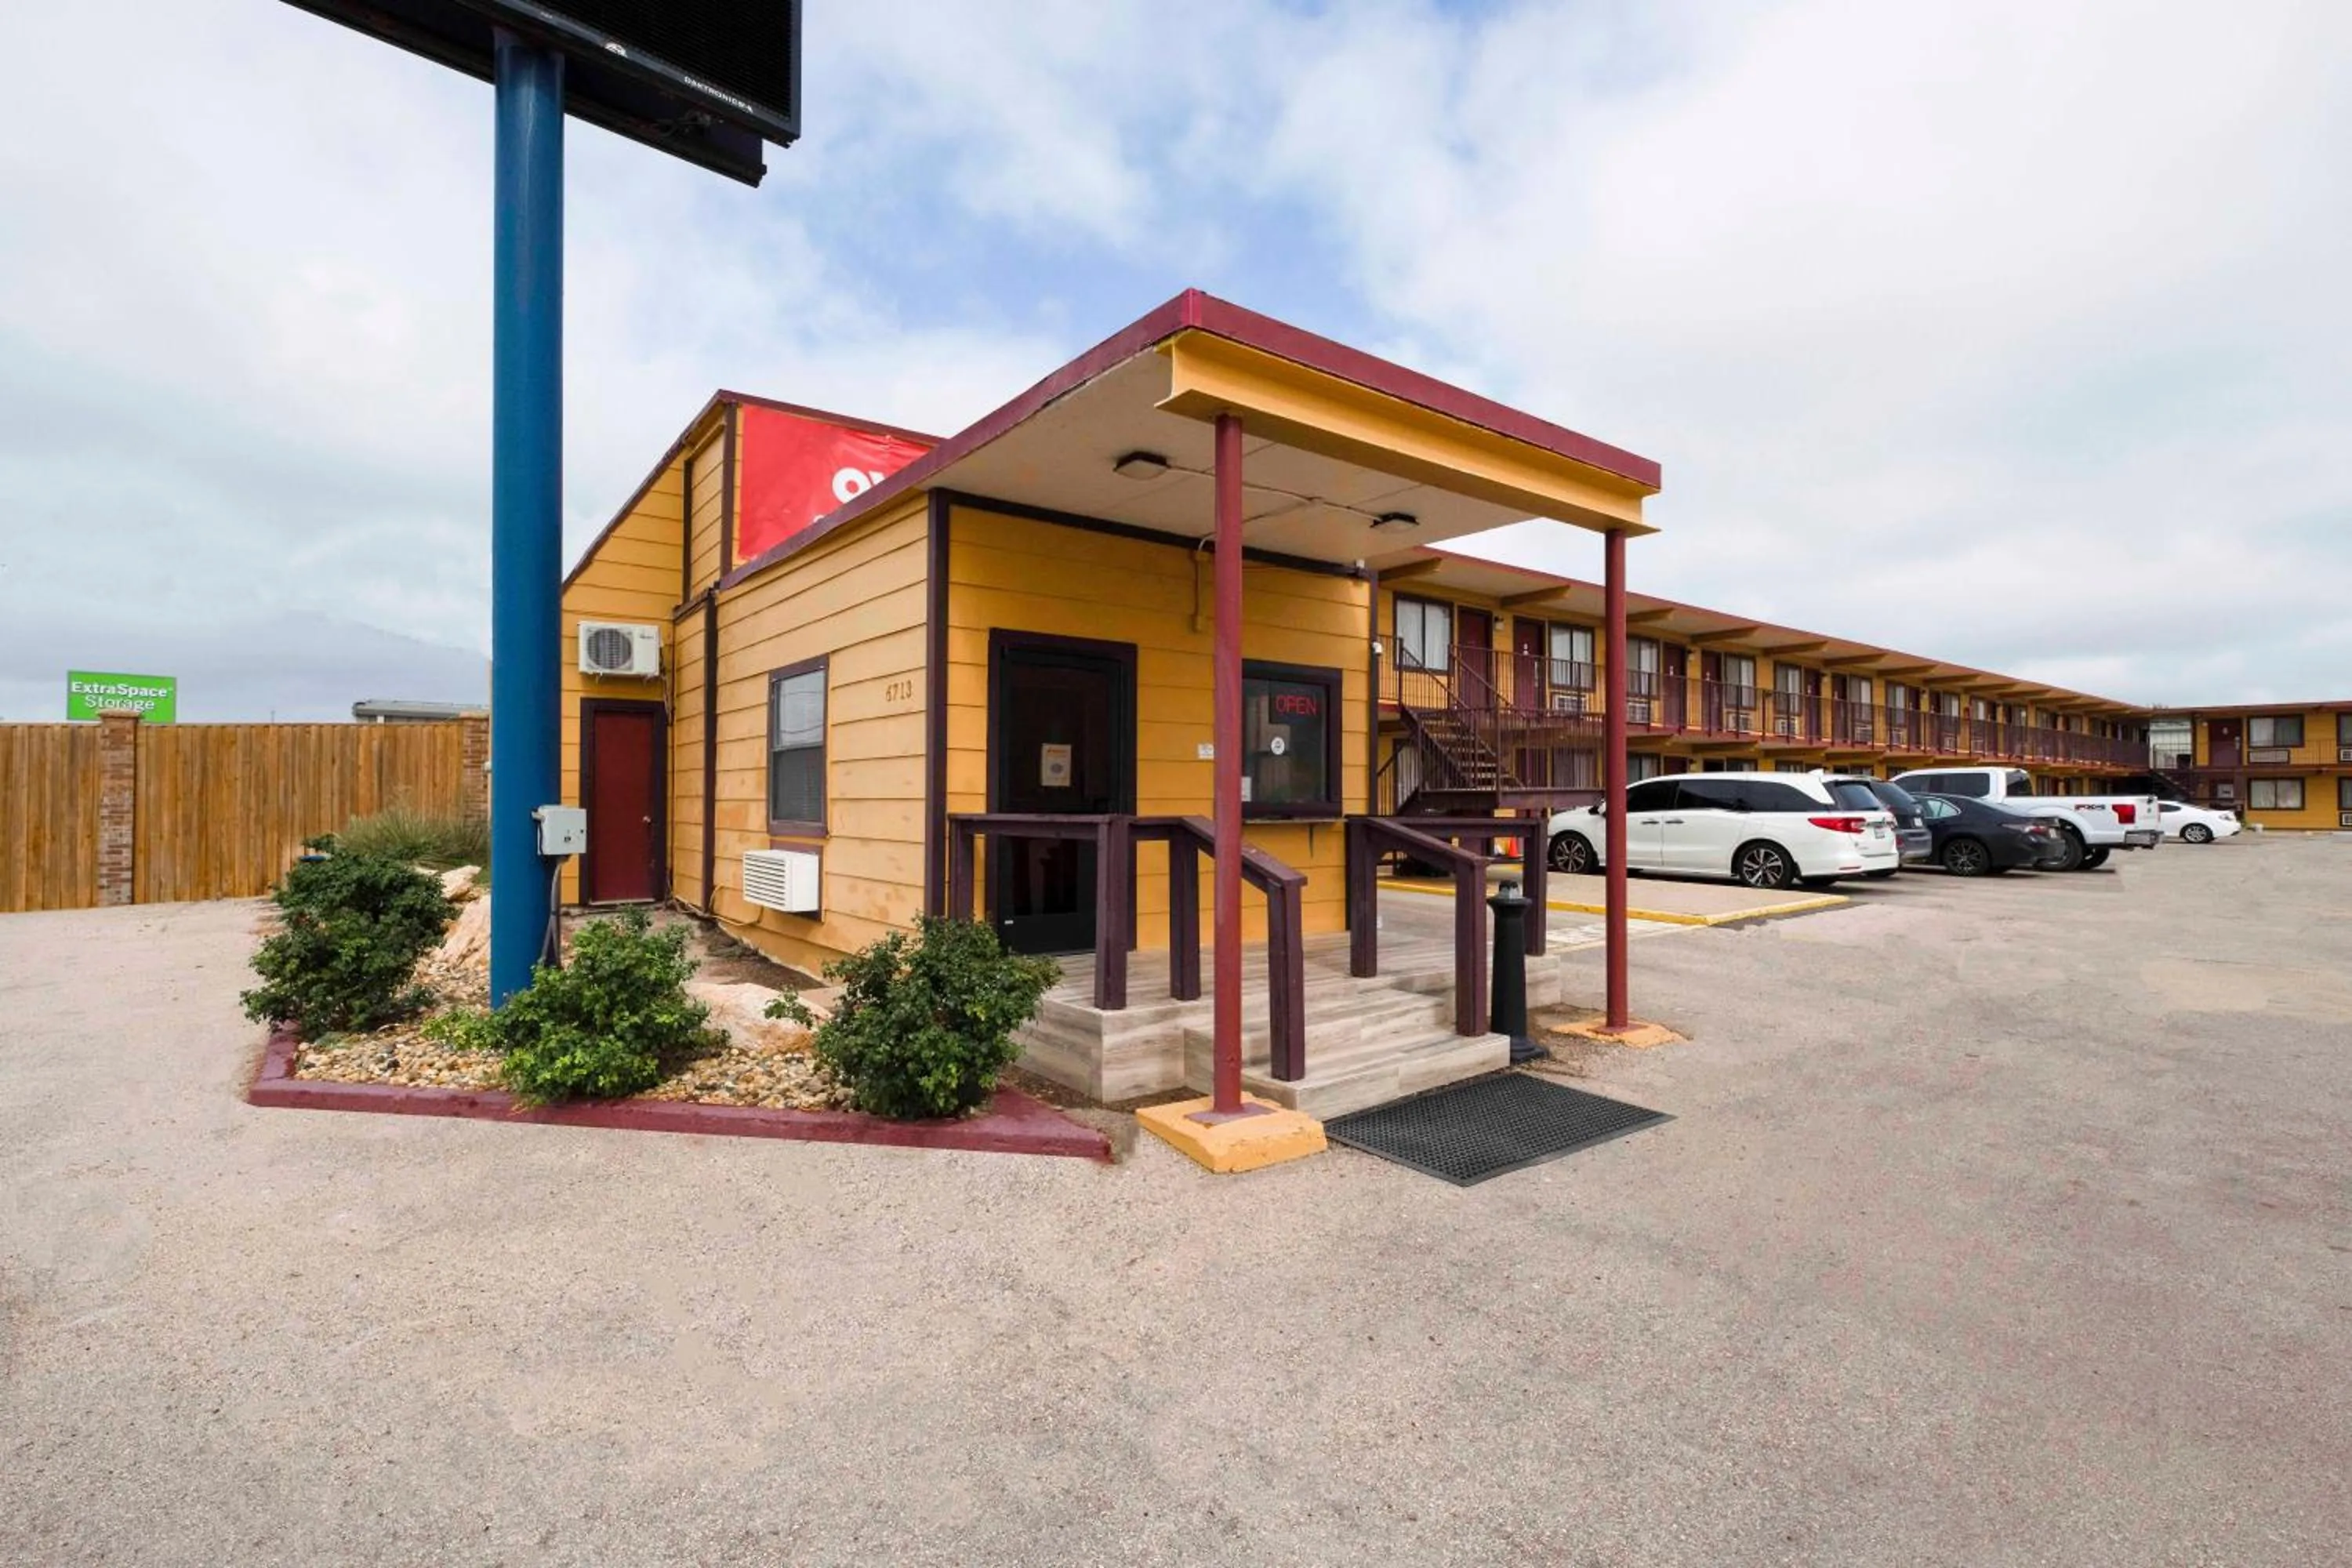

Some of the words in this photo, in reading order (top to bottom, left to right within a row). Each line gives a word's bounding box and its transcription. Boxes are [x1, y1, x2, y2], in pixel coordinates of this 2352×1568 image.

[71, 681, 167, 699] ExtraSpace
[85, 695, 155, 712] Storage
[1276, 695, 1317, 716] OPEN
